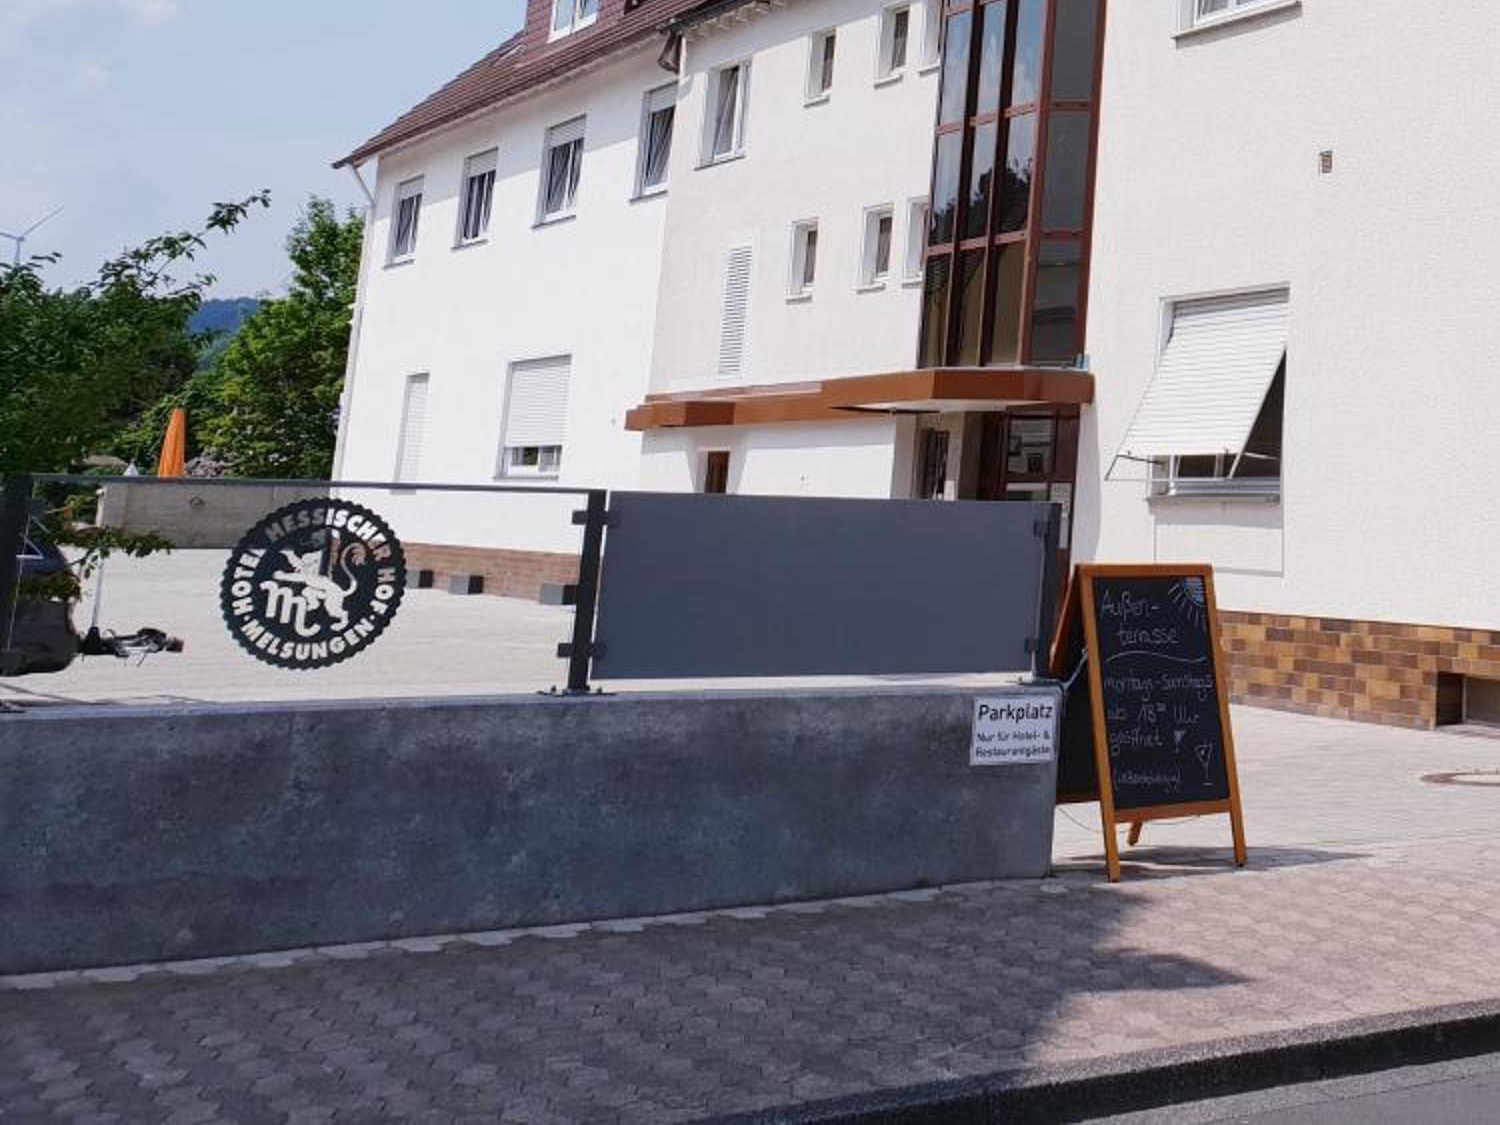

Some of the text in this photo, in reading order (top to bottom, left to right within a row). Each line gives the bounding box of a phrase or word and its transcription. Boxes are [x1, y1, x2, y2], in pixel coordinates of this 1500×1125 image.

[231, 507, 397, 616] HOTEL HESSISCHER HOF
[239, 617, 376, 661] MELSUNGEN
[978, 703, 1053, 724] Parkplatz
[977, 732, 995, 742] Nur
[997, 731, 1010, 742] für
